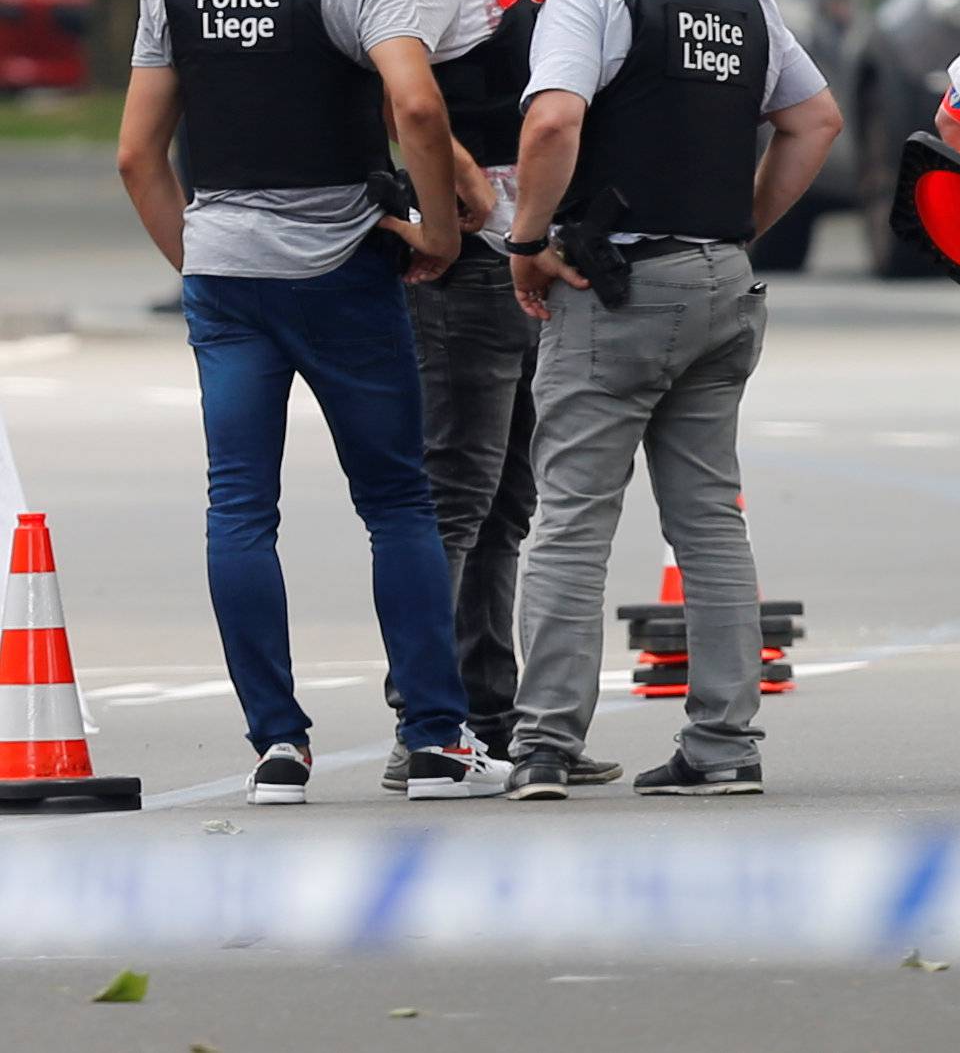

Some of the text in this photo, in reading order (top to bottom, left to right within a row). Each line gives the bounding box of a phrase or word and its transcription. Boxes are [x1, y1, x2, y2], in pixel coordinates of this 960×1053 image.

[202, 10, 275, 48] Liege
[678, 11, 743, 46] Police
[683, 41, 741, 82] Liege
